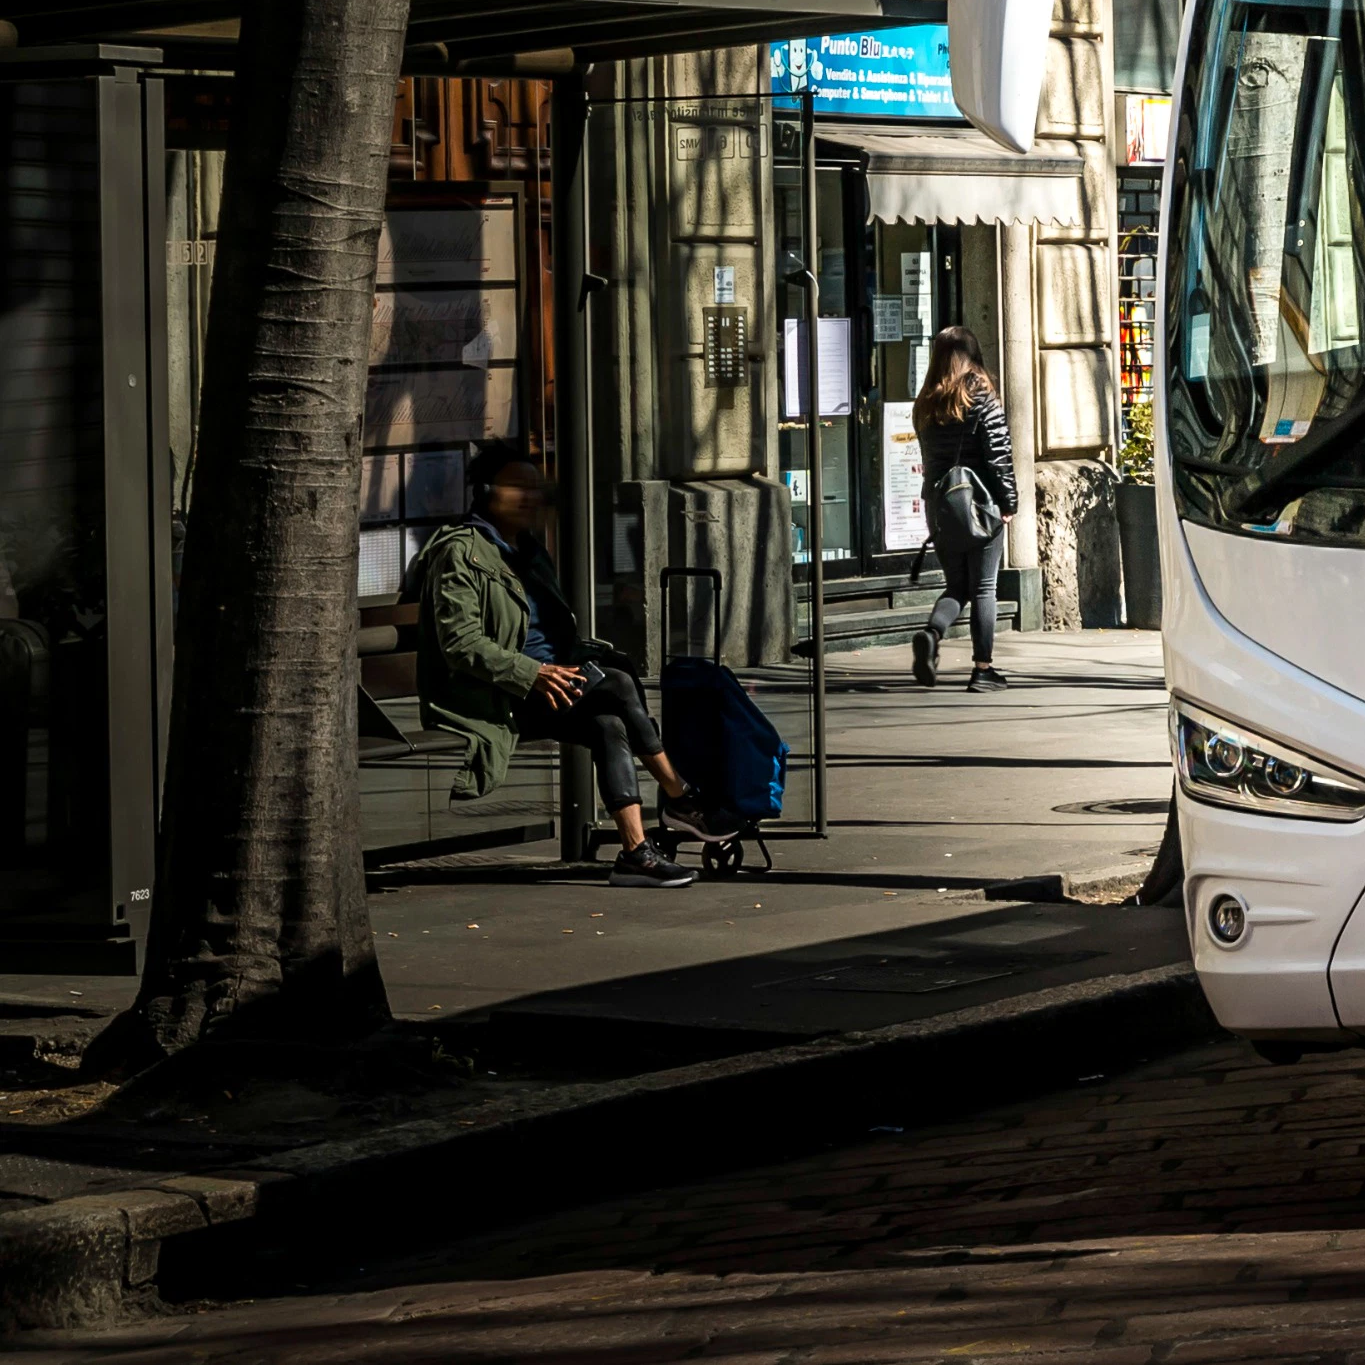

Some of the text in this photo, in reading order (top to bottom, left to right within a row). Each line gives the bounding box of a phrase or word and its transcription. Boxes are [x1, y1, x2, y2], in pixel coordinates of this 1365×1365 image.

[821, 36, 881, 58] Punto Blu
[826, 68, 856, 82] Vendita
[866, 70, 908, 85] Assistenza
[811, 85, 851, 101] Computer
[860, 87, 908, 103] Smartphone
[917, 89, 942, 104] Tablet
[130, 888, 150, 902] 7623
